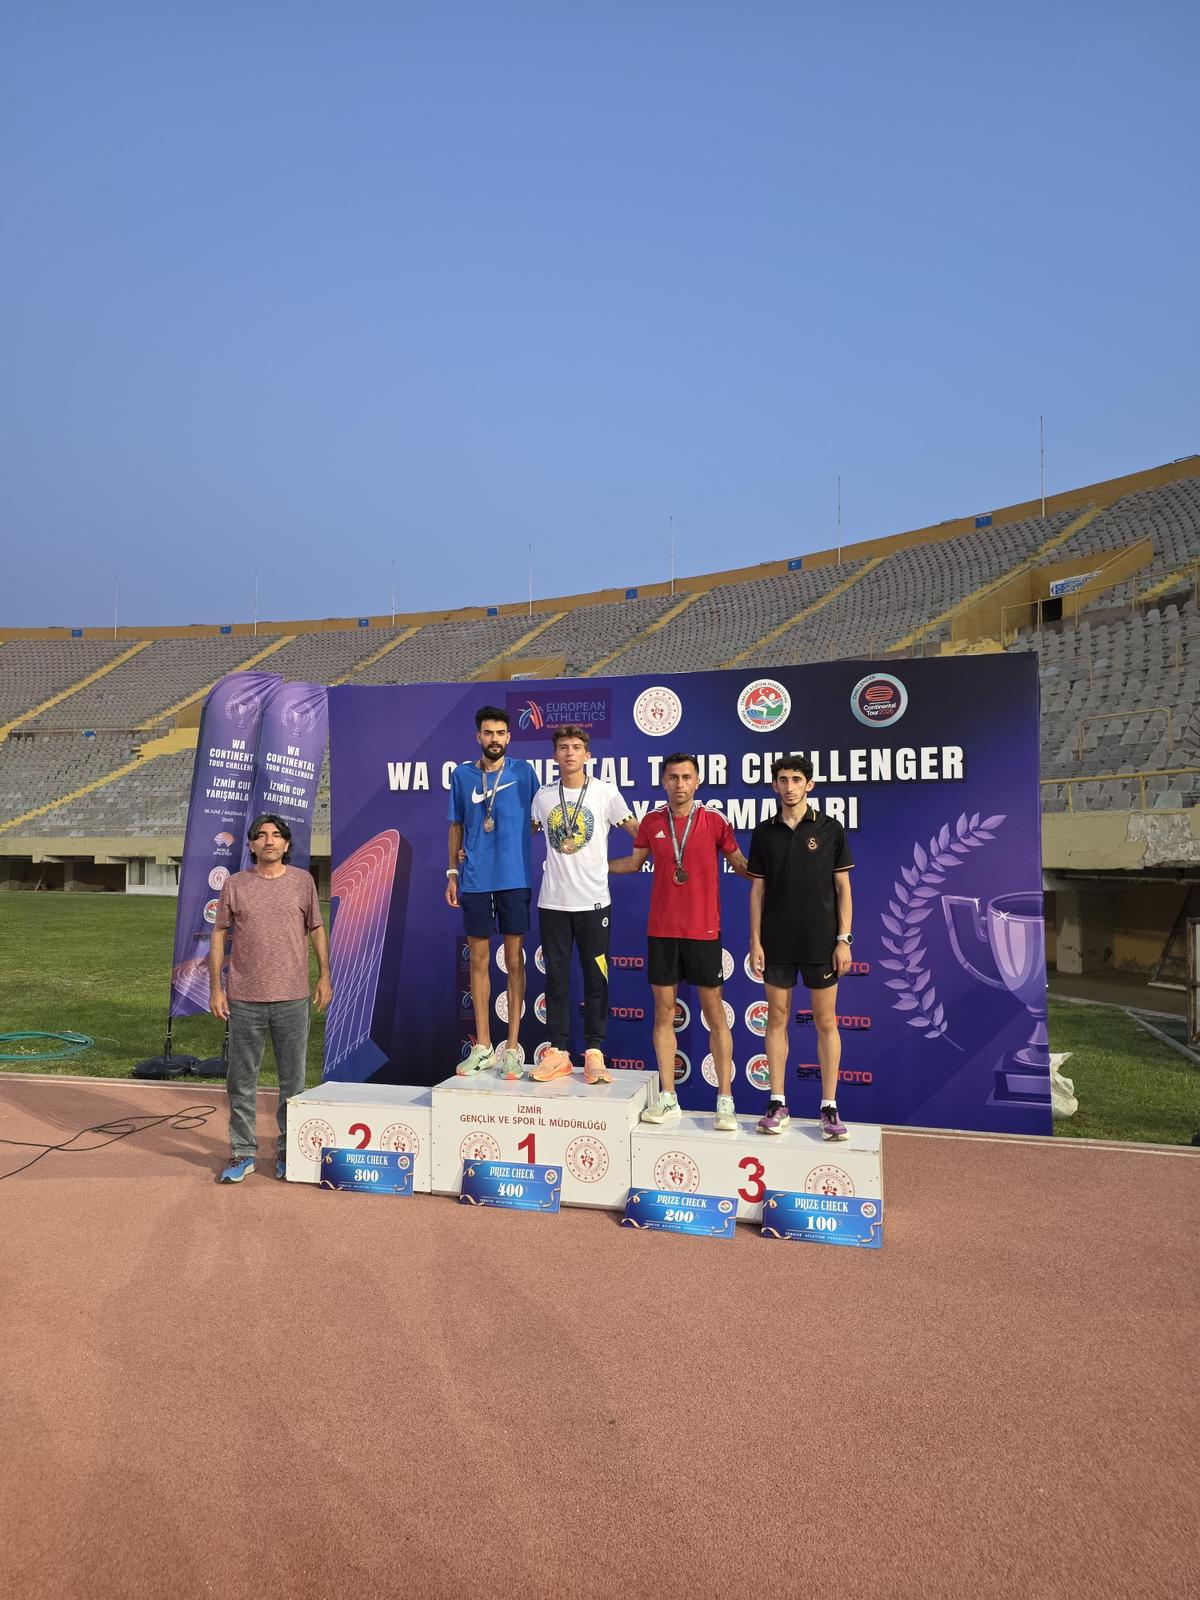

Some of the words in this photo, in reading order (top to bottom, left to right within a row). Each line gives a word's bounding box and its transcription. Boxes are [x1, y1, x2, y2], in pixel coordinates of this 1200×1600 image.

[546, 701, 606, 712] EUROPEAN
[863, 702, 897, 711] Continental
[546, 711, 606, 722] ATHLETICS
[232, 739, 246, 750] WA
[287, 745, 300, 756] WA
[209, 748, 255, 763] CONTINENT
[266, 752, 316, 772] CONTINENTAL
[208, 759, 224, 768] TOUR
[387, 761, 429, 791] WA
[647, 753, 727, 786] TUR
[741, 745, 963, 784] CHLLENGER
[265, 763, 280, 773] TOUR
[281, 766, 314, 780] CHALLENGER
[213, 776, 236, 788] İZMİR
[269, 780, 291, 794] İZMİR
[292, 786, 306, 797] CUP
[205, 789, 249, 802] YARIŞMALA
[263, 791, 309, 809] YARIŞMALARI
[611, 956, 645, 968] TOTO
[851, 961, 871, 974] TO
[611, 1007, 645, 1018] TOTO
[611, 1058, 645, 1070] TOTO
[517, 1103, 542, 1114] İZMİR
[459, 1114, 496, 1124] GENÇLİK
[498, 1115, 509, 1124] VE
[512, 1116, 535, 1126] SPOR
[538, 1116, 546, 1126] İL
[549, 1117, 607, 1131] MÜDÜRLÜĞÜ
[348, 1122, 372, 1150] 2
[517, 1132, 536, 1165] 1
[346, 1153, 366, 1166] PRIZE
[366, 1155, 389, 1166] CHECK
[354, 1168, 379, 1183] 300
[489, 1166, 510, 1179] PRIZE
[511, 1168, 535, 1180] CHECK
[737, 1156, 767, 1204] 3
[497, 1182, 524, 1198] 400
[656, 1194, 681, 1206] PRIZE
[681, 1197, 708, 1209] CHECK
[794, 1197, 820, 1211] PRIZE
[821, 1200, 849, 1213] CHECK
[663, 1208, 695, 1224] 200
[806, 1216, 838, 1232] 100
